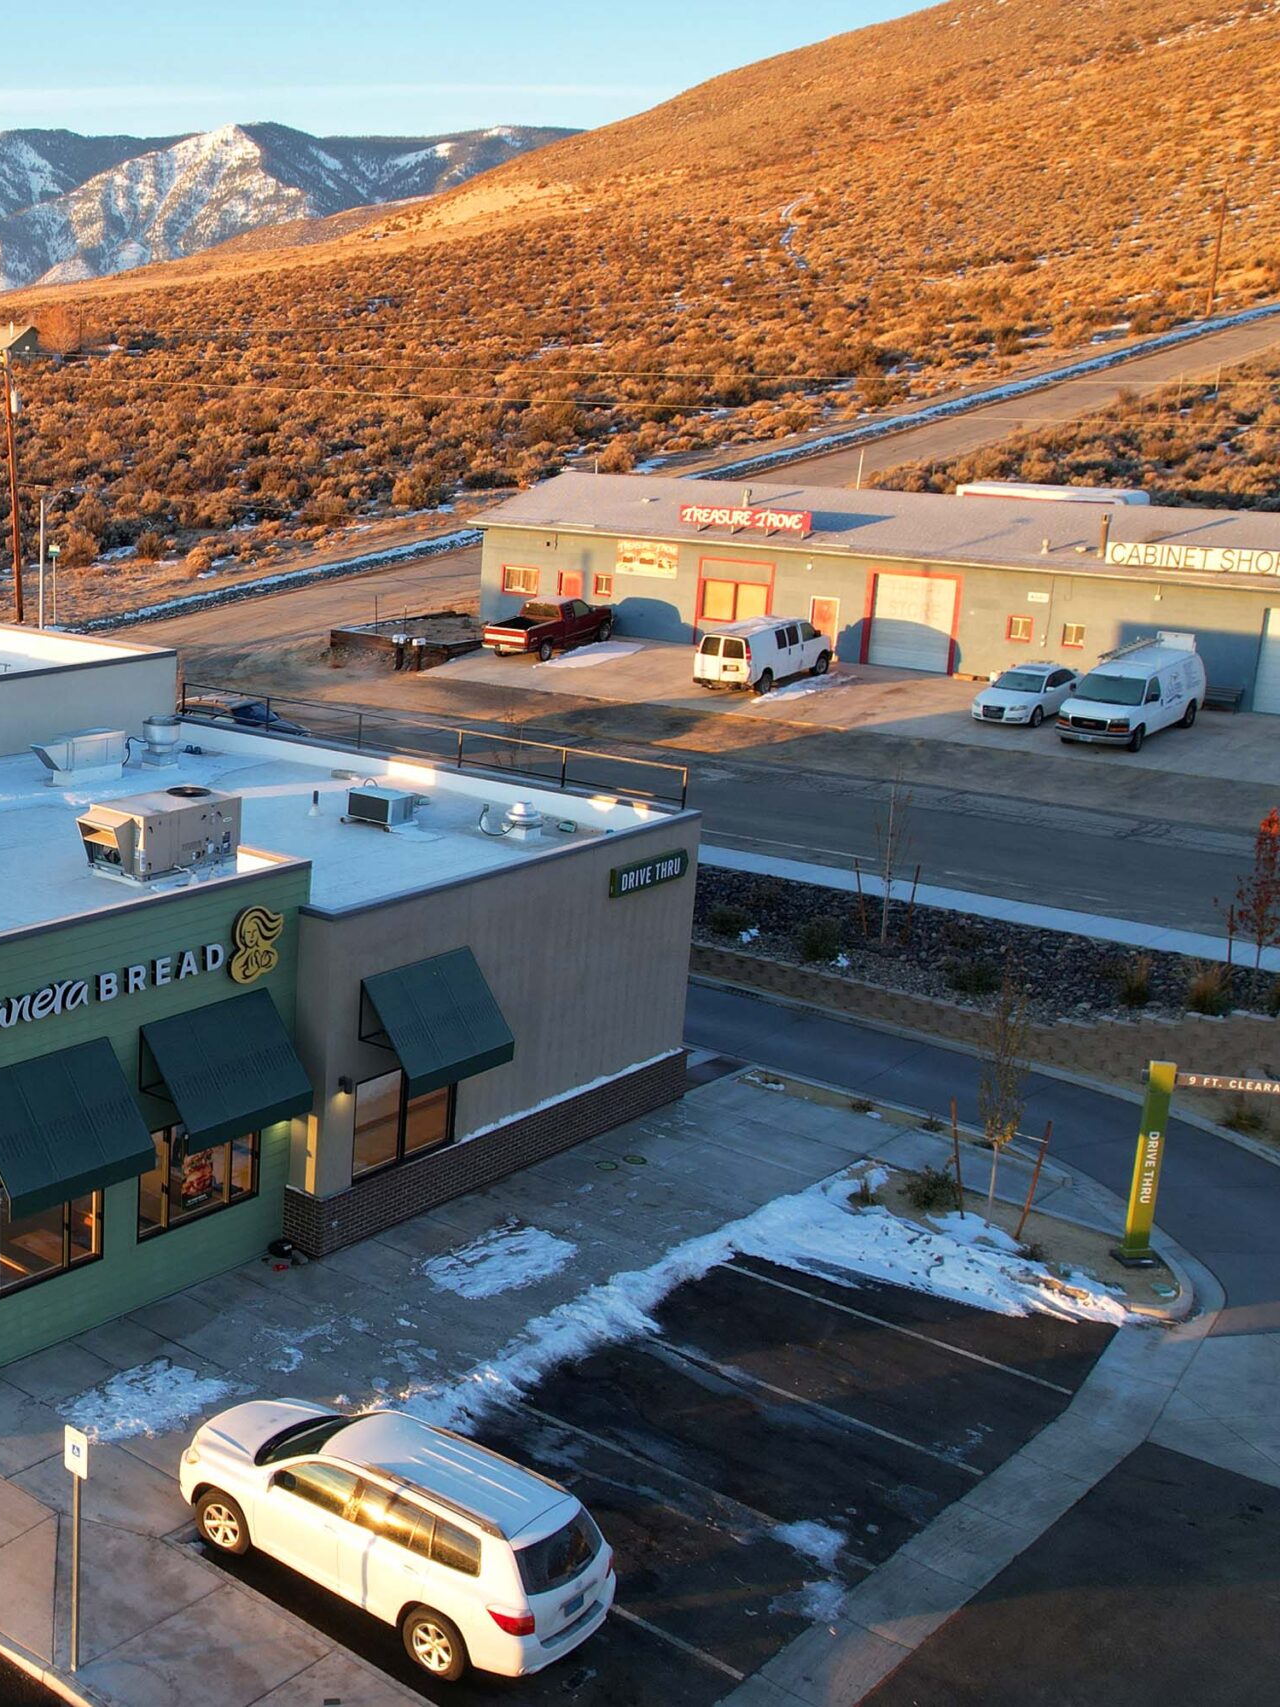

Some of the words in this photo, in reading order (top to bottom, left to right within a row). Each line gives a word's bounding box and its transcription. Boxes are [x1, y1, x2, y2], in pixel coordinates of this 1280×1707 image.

[681, 506, 752, 525] TREASURE
[754, 509, 803, 529] TROVE
[1110, 543, 1213, 569] CABINET
[621, 866, 653, 892] DRIVE
[655, 857, 681, 880] THRU
[95, 943, 225, 1003] BREAD
[1188, 1076, 1196, 1086] 9
[1203, 1077, 1222, 1088] FT.
[1144, 1131, 1160, 1168] DRIVE
[1139, 1170, 1155, 1204] THRU
